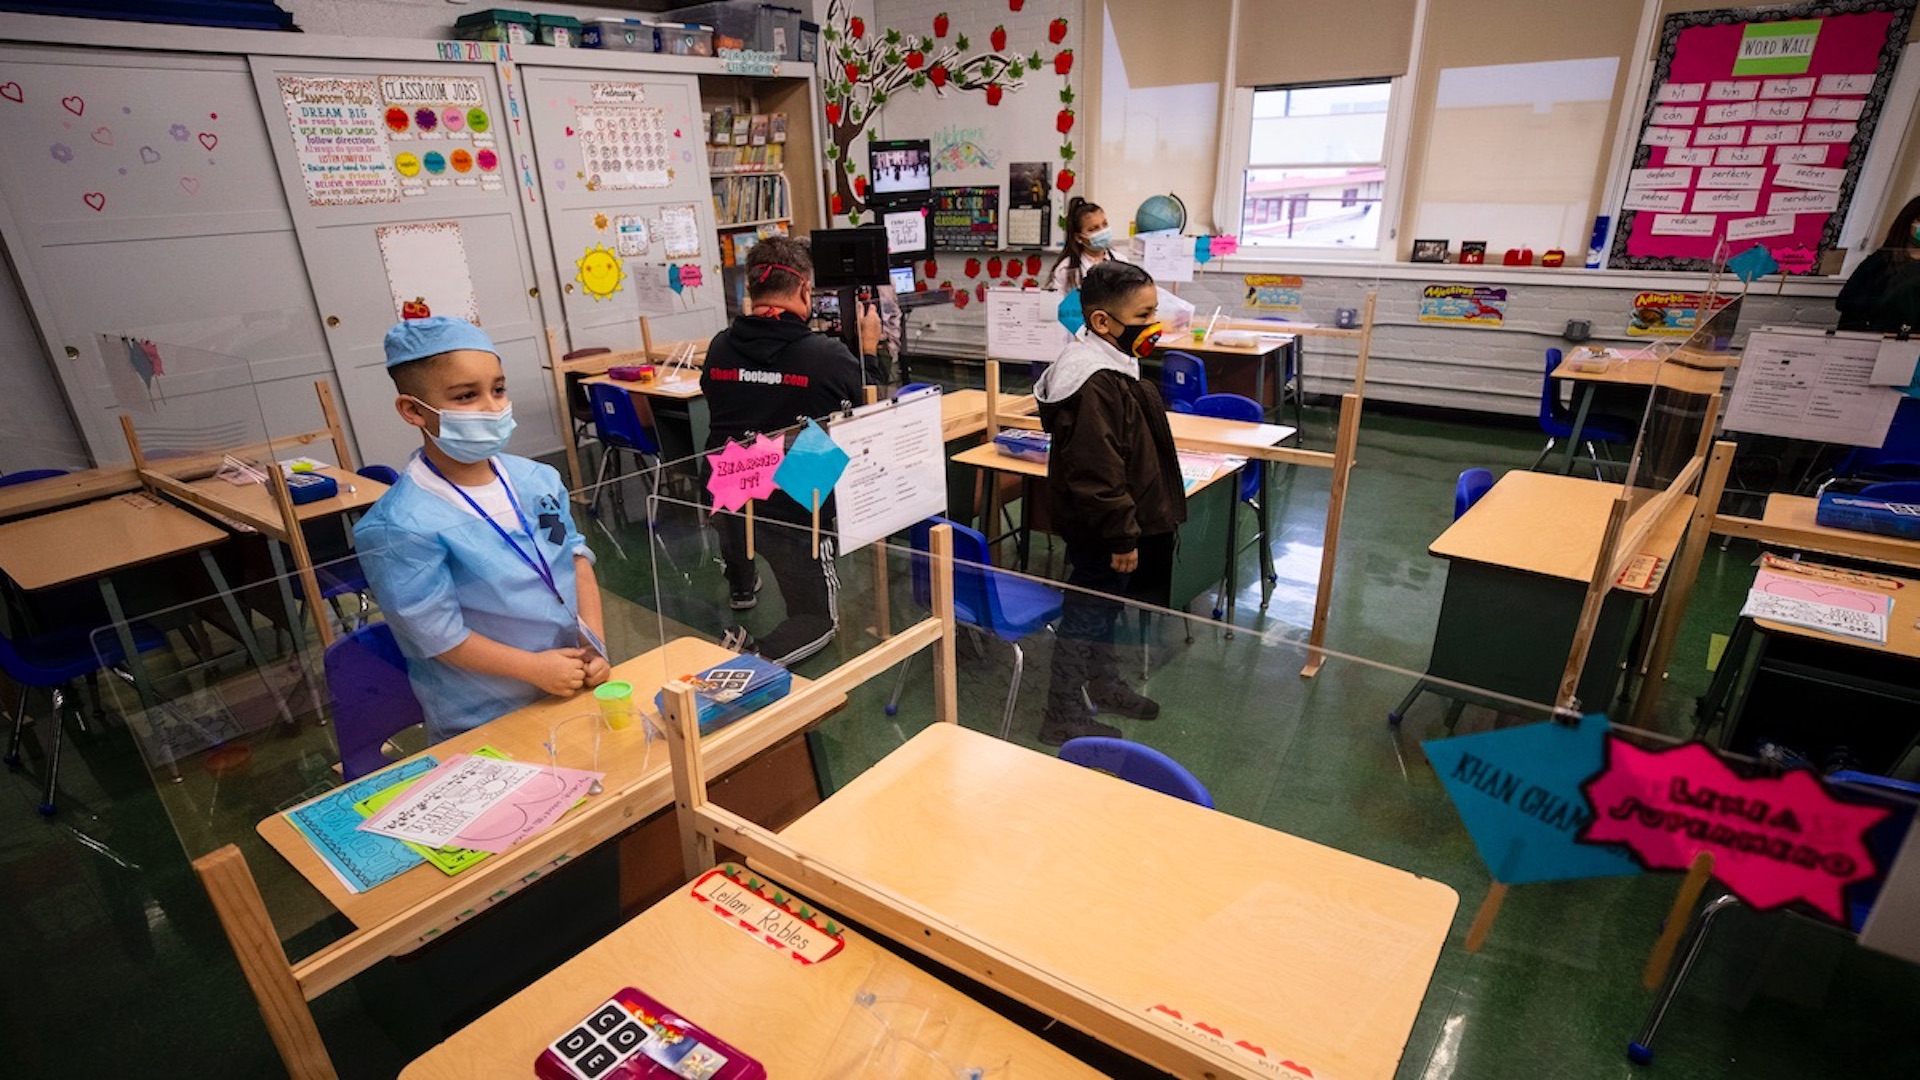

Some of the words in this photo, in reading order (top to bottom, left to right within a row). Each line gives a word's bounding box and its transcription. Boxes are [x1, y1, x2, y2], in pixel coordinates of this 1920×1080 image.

[1745, 40, 1777, 56] WORD
[1781, 37, 1811, 54] WALL
[385, 82, 448, 100] CLASSROOM
[453, 83, 477, 100] JOBS
[600, 88, 636, 100] February
[1773, 86, 1798, 95] help
[301, 107, 343, 118] DREAM
[348, 108, 368, 118] BIG
[1662, 112, 1683, 120] can
[1721, 108, 1739, 118] for
[1769, 106, 1791, 116] had
[300, 127, 316, 135] USE
[320, 127, 343, 135] KIND
[346, 127, 378, 135] WORDS
[1764, 131, 1783, 141] sat
[306, 136, 333, 145] follow
[336, 135, 375, 145] directions
[1656, 133, 1674, 141] why
[1708, 133, 1728, 141] bad
[1730, 152, 1750, 161] has
[1646, 170, 1677, 179] depend
[1712, 170, 1753, 179] perfectly
[1796, 169, 1825, 178] secret
[1711, 192, 1740, 201] afraid
[1782, 195, 1826, 203] nervously
[1670, 217, 1698, 225] rescue
[1744, 219, 1777, 228] actions
[1425, 286, 1475, 298] Adjectives
[1637, 294, 1685, 306] Adverbs
[709, 367, 809, 388] SharkFootage.com
[717, 453, 781, 477] ZEARNED
[740, 471, 761, 490] IT!
[1452, 752, 1523, 804] KHAN
[1609, 796, 1857, 878] SUPERHERO
[708, 881, 755, 915] Leilani
[756, 908, 810, 950] Robles
